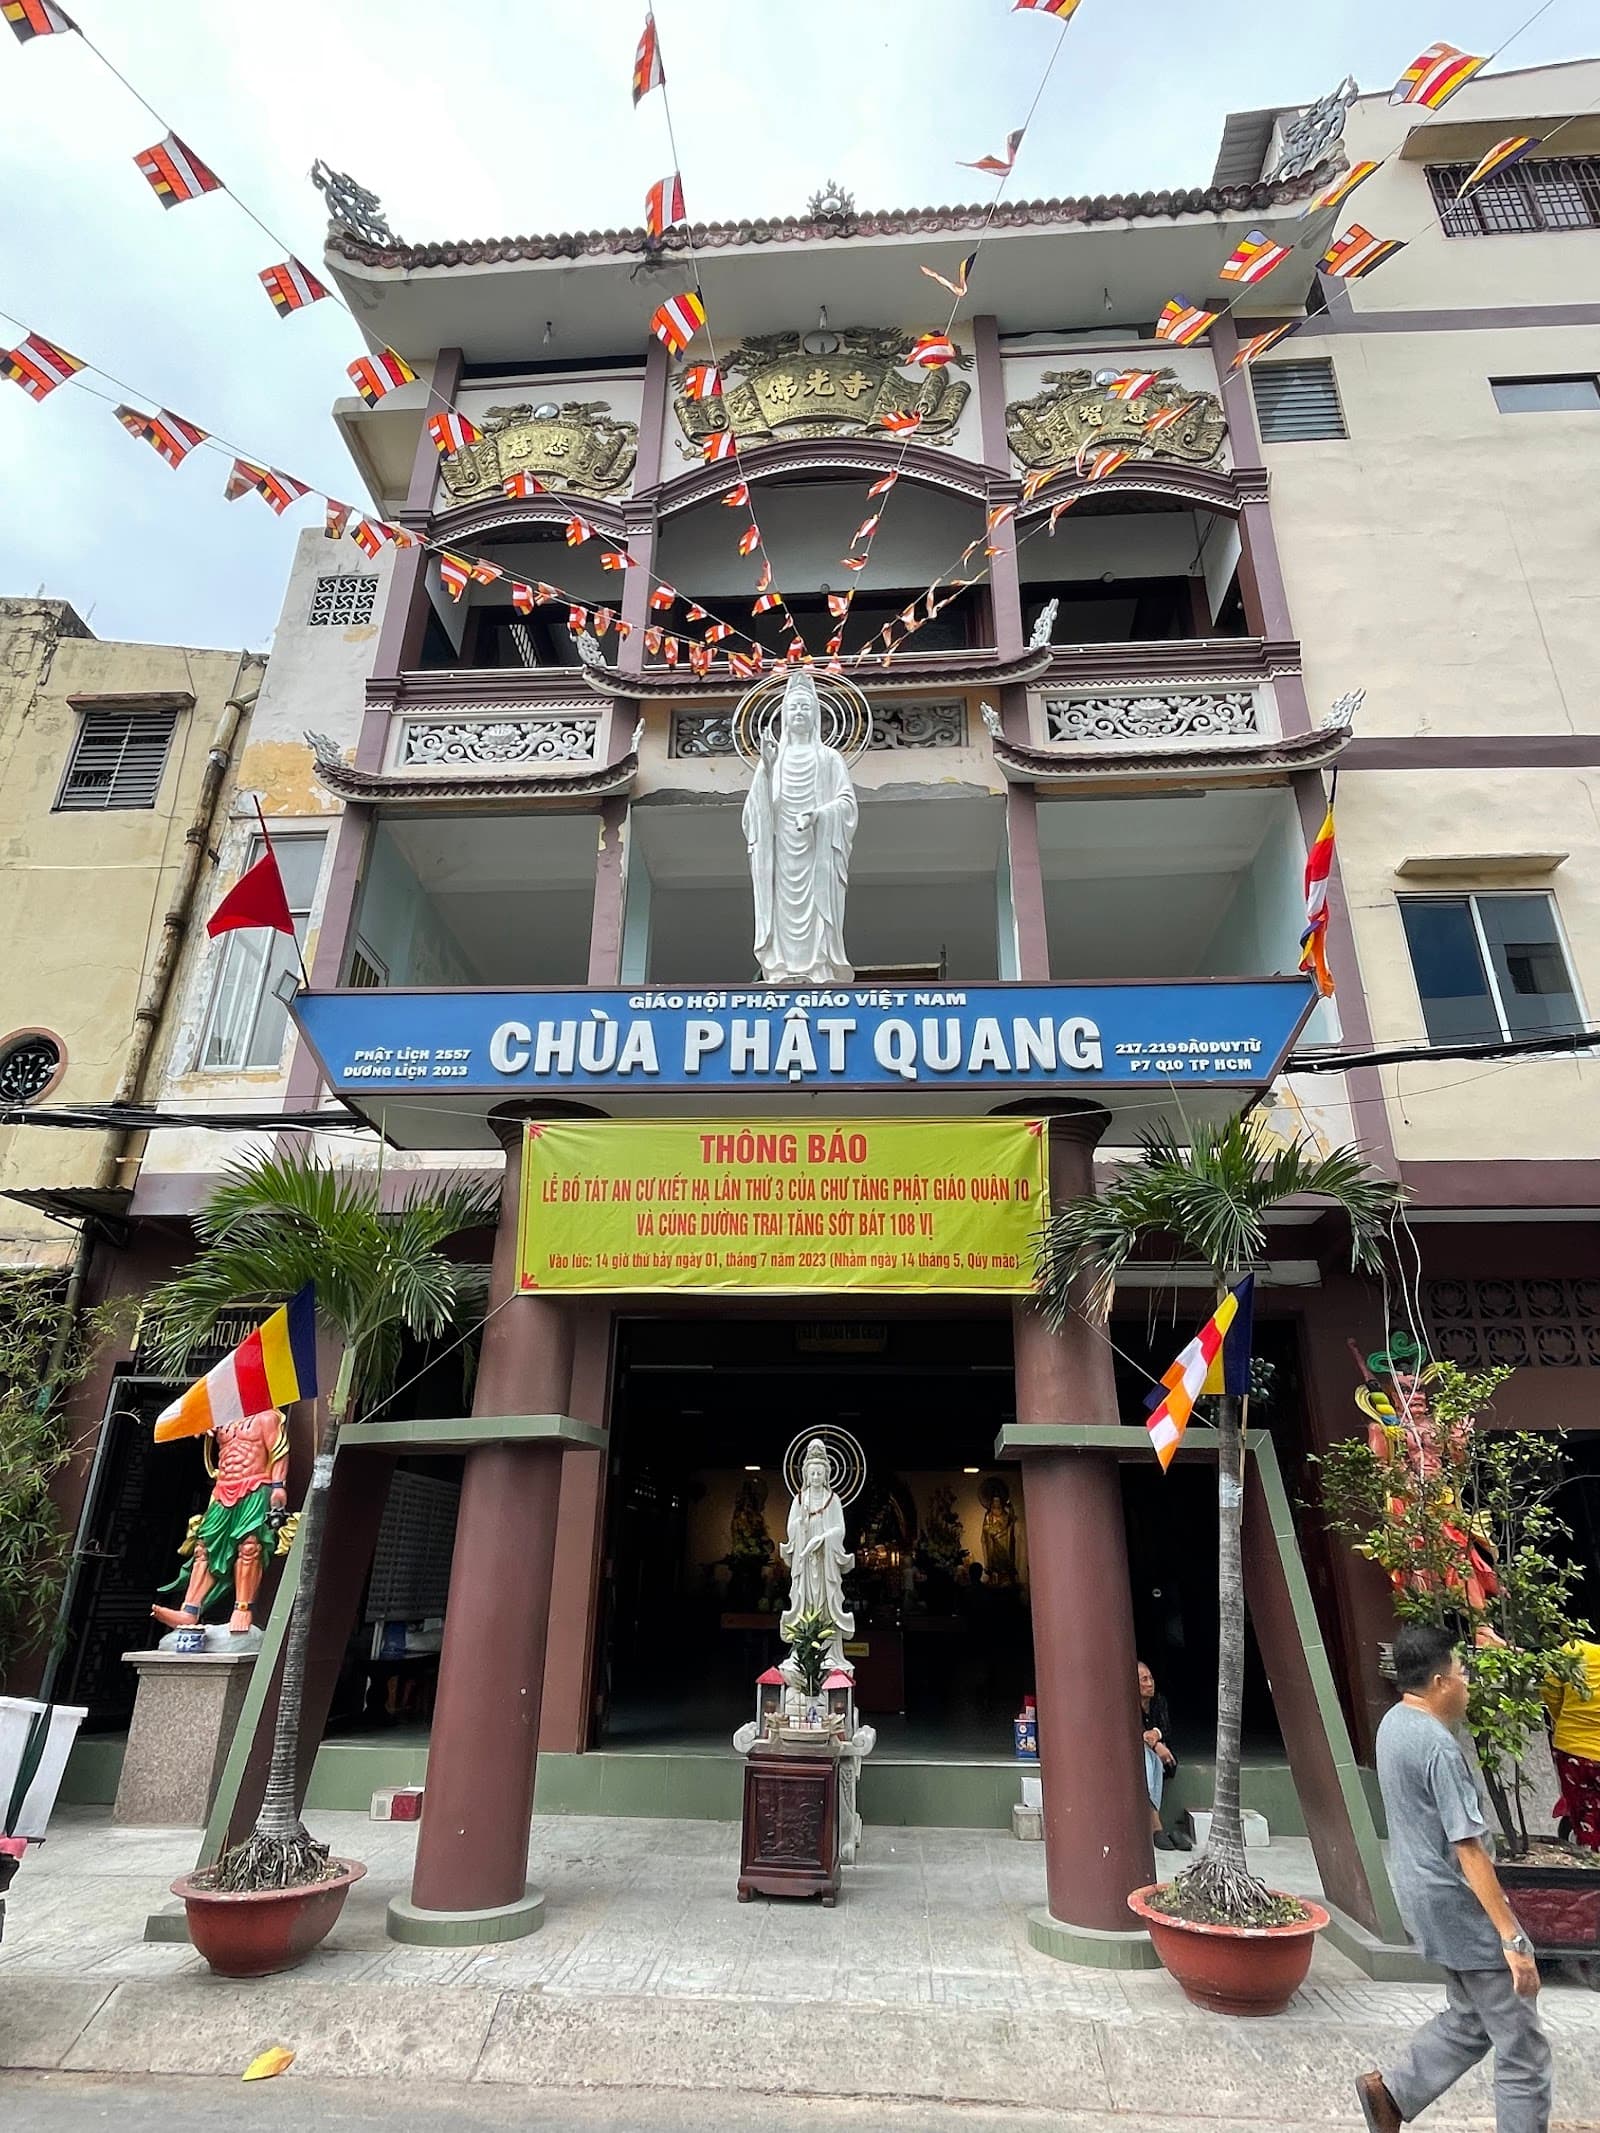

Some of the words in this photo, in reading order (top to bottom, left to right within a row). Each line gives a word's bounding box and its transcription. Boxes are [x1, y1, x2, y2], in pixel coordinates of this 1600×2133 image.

[765, 368, 874, 405] 佛光寺
[1079, 401, 1149, 427] 智慧
[731, 991, 791, 1011] PHẬT
[914, 993, 967, 1006] NAM
[354, 1046, 394, 1064] PHẬT
[435, 1049, 472, 1060] 2557
[489, 1009, 660, 1074] CHÙA
[684, 1007, 857, 1082] PHẬT
[873, 1016, 1103, 1080] QUANG
[432, 1066, 469, 1077] 2013
[1130, 1060, 1151, 1071] P7
[1155, 1060, 1184, 1072] Q10
[1189, 1059, 1210, 1071] TP
[1214, 1059, 1252, 1071] HCM
[700, 1128, 797, 1164] THÔNG
[808, 1127, 867, 1164] BÁO
[543, 1172, 558, 1202] LỄ
[562, 1172, 581, 1202] BỐ
[585, 1175, 608, 1202] TÁT
[612, 1179, 631, 1202] AN
[636, 1177, 656, 1201] CƯ
[658, 1172, 688, 1201] KIẾT
[691, 1179, 710, 1206] HẠ
[745, 1173, 773, 1201] THỨ
[775, 1179, 784, 1201] 3
[788, 1171, 816, 1201] CỦA
[821, 1176, 850, 1201] CHƯ
[852, 1174, 889, 1201] TĂNG
[893, 1173, 928, 1206] PHẬT
[933, 1173, 966, 1201] GIÁO
[970, 1173, 1010, 1206] QUẬN
[1014, 1178, 1030, 1201] 10
[637, 1208, 654, 1236] VÀ
[659, 1208, 696, 1236] CÚNG
[701, 1207, 748, 1236] DƯỜNG
[753, 1213, 783, 1236] TRAI
[787, 1208, 824, 1236] TĂNG
[828, 1208, 854, 1236] SỚT
[859, 1208, 885, 1236] BÁT
[890, 1212, 915, 1236] 108
[919, 1212, 933, 1240] VỊ
[549, 1253, 568, 1268] Vào
[572, 1253, 592, 1268] lúc:
[596, 1253, 608, 1267] 14
[612, 1253, 629, 1269] giờ
[633, 1252, 650, 1268] thứ
[653, 1251, 673, 1268] bảy
[675, 1252, 702, 1268] ngày
[705, 1252, 722, 1268] 01,
[726, 1252, 757, 1268] tháng
[760, 1253, 767, 1267] 7
[770, 1252, 795, 1267] năm
[798, 1252, 826, 1267] 2023
[870, 1252, 897, 1268] ngày
[901, 1253, 915, 1267] 14
[918, 1252, 950, 1268] tháng
[967, 1251, 988, 1269] Qúy
